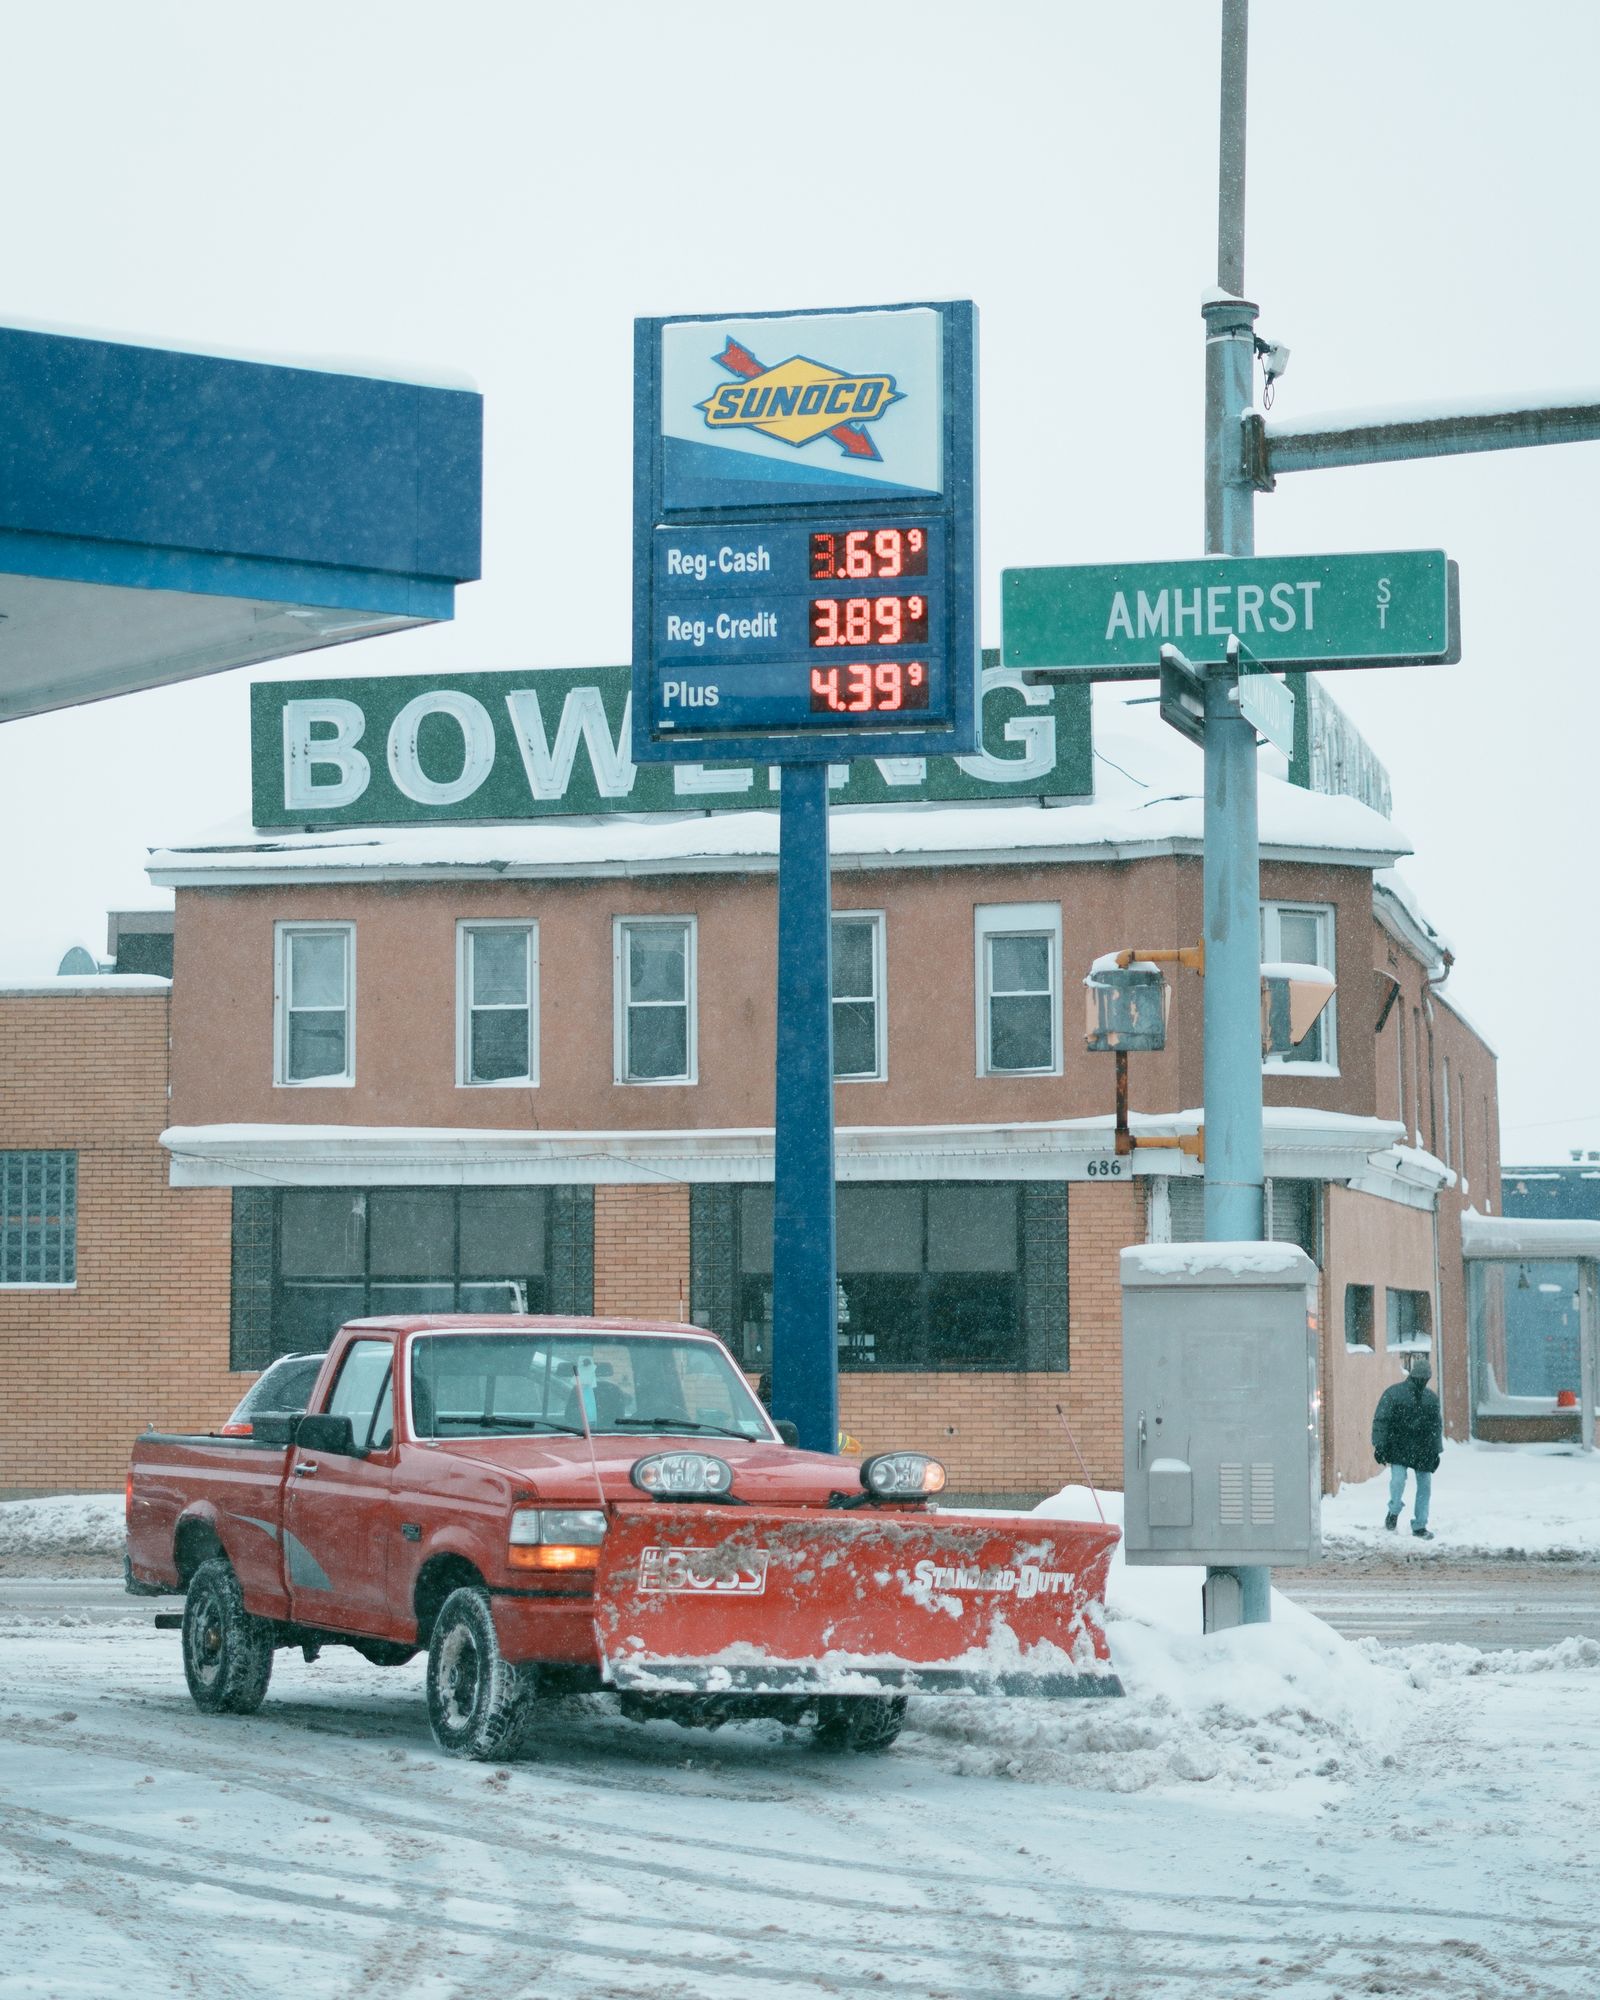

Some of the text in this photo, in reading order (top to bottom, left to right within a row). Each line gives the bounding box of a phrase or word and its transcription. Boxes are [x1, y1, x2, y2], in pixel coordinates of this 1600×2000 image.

[713, 381, 885, 420] SUNOCO
[667, 546, 771, 581] Reg-Cash
[1105, 581, 1321, 640] AMHERST
[667, 613, 778, 647] Reg-Credit
[663, 681, 720, 708] Plus
[283, 667, 1056, 809] BOWG
[1087, 1160, 1121, 1176] 686
